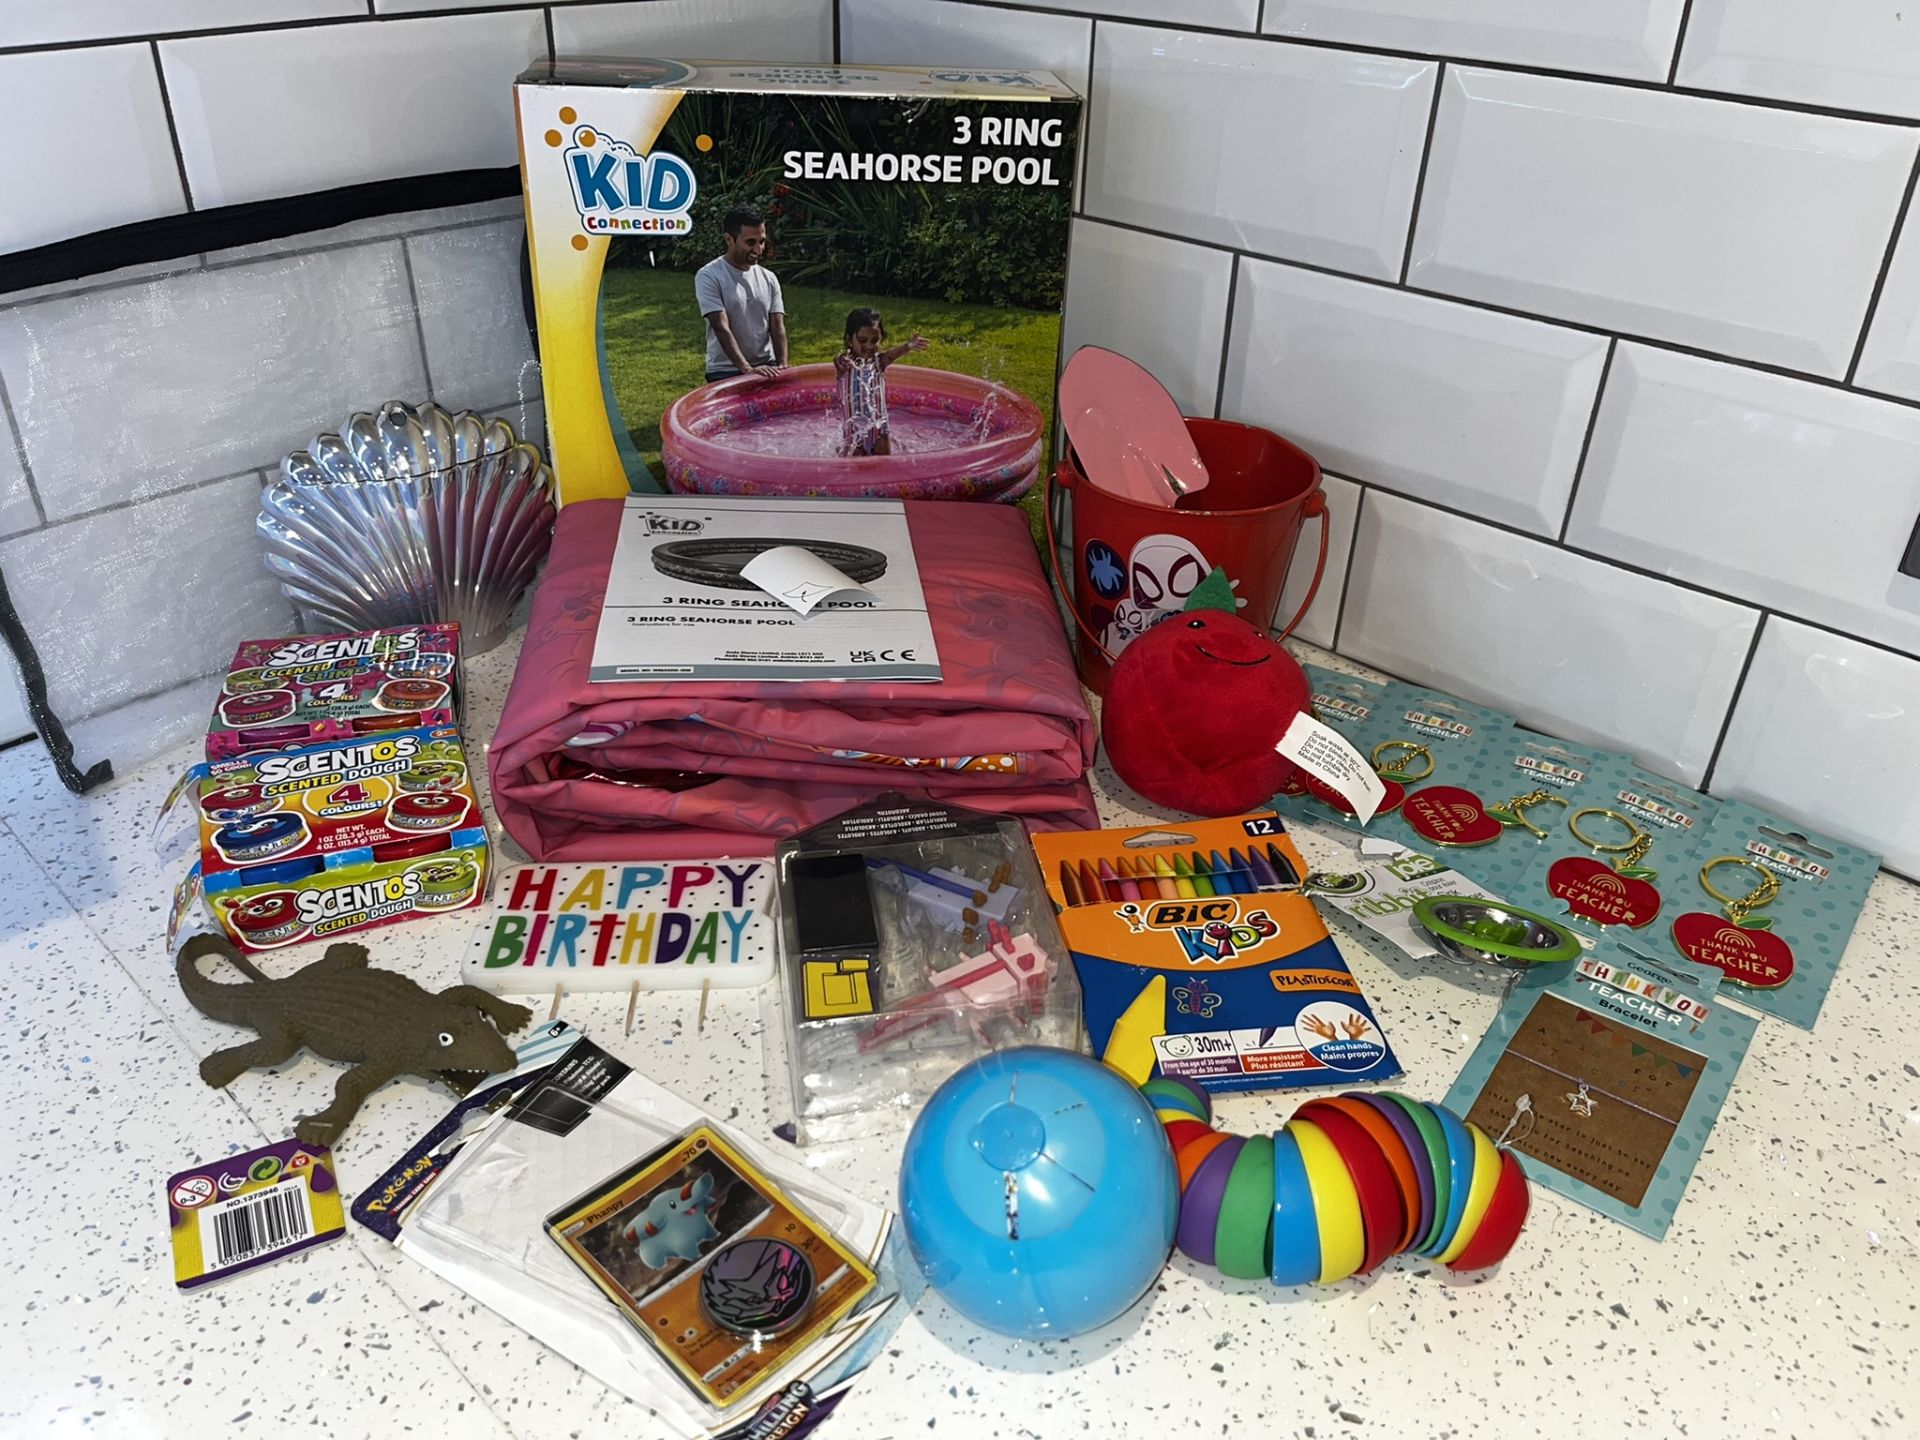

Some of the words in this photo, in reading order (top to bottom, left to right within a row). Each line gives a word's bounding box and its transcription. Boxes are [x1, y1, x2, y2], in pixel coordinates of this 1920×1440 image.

[953, 116, 972, 145] 3
[981, 117, 1063, 147] RING
[783, 151, 963, 184] SEAHORSE
[971, 156, 1060, 187] POOL
[571, 153, 692, 212] KID
[587, 216, 686, 231] Connection
[649, 519, 702, 531] KID
[662, 597, 674, 605] 3
[679, 598, 726, 606] RING
[827, 601, 877, 609] POOL
[680, 616, 753, 625] SEAHORSE
[269, 662, 331, 677] SCENTED
[319, 683, 347, 700] 4
[1410, 724, 1460, 740] TEACHER
[1449, 722, 1473, 735] YOU
[1304, 741, 1314, 749] Do
[1314, 746, 1325, 756] not
[1325, 752, 1336, 762] dry
[1311, 730, 1327, 742] Soak
[1328, 739, 1344, 753] wash
[210, 760, 248, 770] SMELLS
[258, 737, 419, 783] SCENTOS
[1297, 750, 1315, 763] Made
[1315, 760, 1322, 768] in
[1322, 764, 1340, 779] China
[1300, 745, 1310, 754] Do
[1311, 752, 1322, 760] not
[1322, 756, 1342, 773] tumble
[1342, 770, 1351, 782] dry
[1308, 736, 1317, 744] Do
[1318, 741, 1329, 750] not
[1348, 763, 1356, 773] Do
[1518, 757, 1560, 774] THANK
[268, 774, 342, 795] SCENTED
[348, 761, 407, 780] DOUGH
[1523, 769, 1576, 788] TEACHER
[330, 783, 370, 804] 4
[319, 801, 384, 816] COLOURS!
[1411, 797, 1456, 840] TEACHER
[1621, 792, 1665, 813] THANK
[1668, 810, 1694, 827] YOU
[1624, 804, 1679, 830] TEACHER
[369, 834, 391, 842] TOTAL
[1244, 819, 1275, 835] 12
[1749, 842, 1800, 865] THANK
[1801, 860, 1831, 878] YOU
[1754, 856, 1814, 882] TEACHER
[299, 873, 421, 923] SCENTOS
[507, 864, 762, 911] HAPPY
[1571, 879, 1607, 898] THANK
[1608, 893, 1634, 908] YOU
[1350, 885, 1430, 918] ribbit
[1556, 883, 1636, 923] TEACHER
[316, 912, 367, 934] SCENTED
[371, 900, 411, 919] DOUGH
[483, 909, 754, 969] BIRTHDAY
[1701, 938, 1740, 957] THANK
[1742, 950, 1768, 964] YOU
[1688, 944, 1779, 980] TEACHER
[1582, 960, 1659, 1002] THANK
[1662, 984, 1709, 1020] YOU
[1587, 980, 1684, 1027] TEACHER
[1598, 998, 1659, 1029] Bracelet
[549, 1026, 561, 1037] 6+
[1194, 1035, 1232, 1054] 30m+
[1320, 1051, 1346, 1061] Mains
[1348, 1050, 1380, 1061] propres
[1322, 1043, 1345, 1052] Clean
[1347, 1042, 1372, 1051] hands
[1164, 1060, 1179, 1069] From
[1190, 1060, 1201, 1069] age
[1201, 1058, 1208, 1066] of
[1207, 1057, 1215, 1066] 30
[1215, 1057, 1237, 1066] months
[1198, 1066, 1206, 1074] de
[1214, 1064, 1229, 1073] mois
[1246, 1054, 1268, 1063] More
[1250, 1061, 1269, 1070] Plus
[180, 1195, 196, 1205] 0-3
[226, 1187, 280, 1208] NO.1373946
[586, 1200, 625, 1225] Phanpy
[784, 1222, 796, 1233] 10
[211, 1262, 217, 1270] 5
[221, 1246, 262, 1267] 050837
[266, 1231, 305, 1251] 394617
[743, 1381, 809, 1440] HILLING
